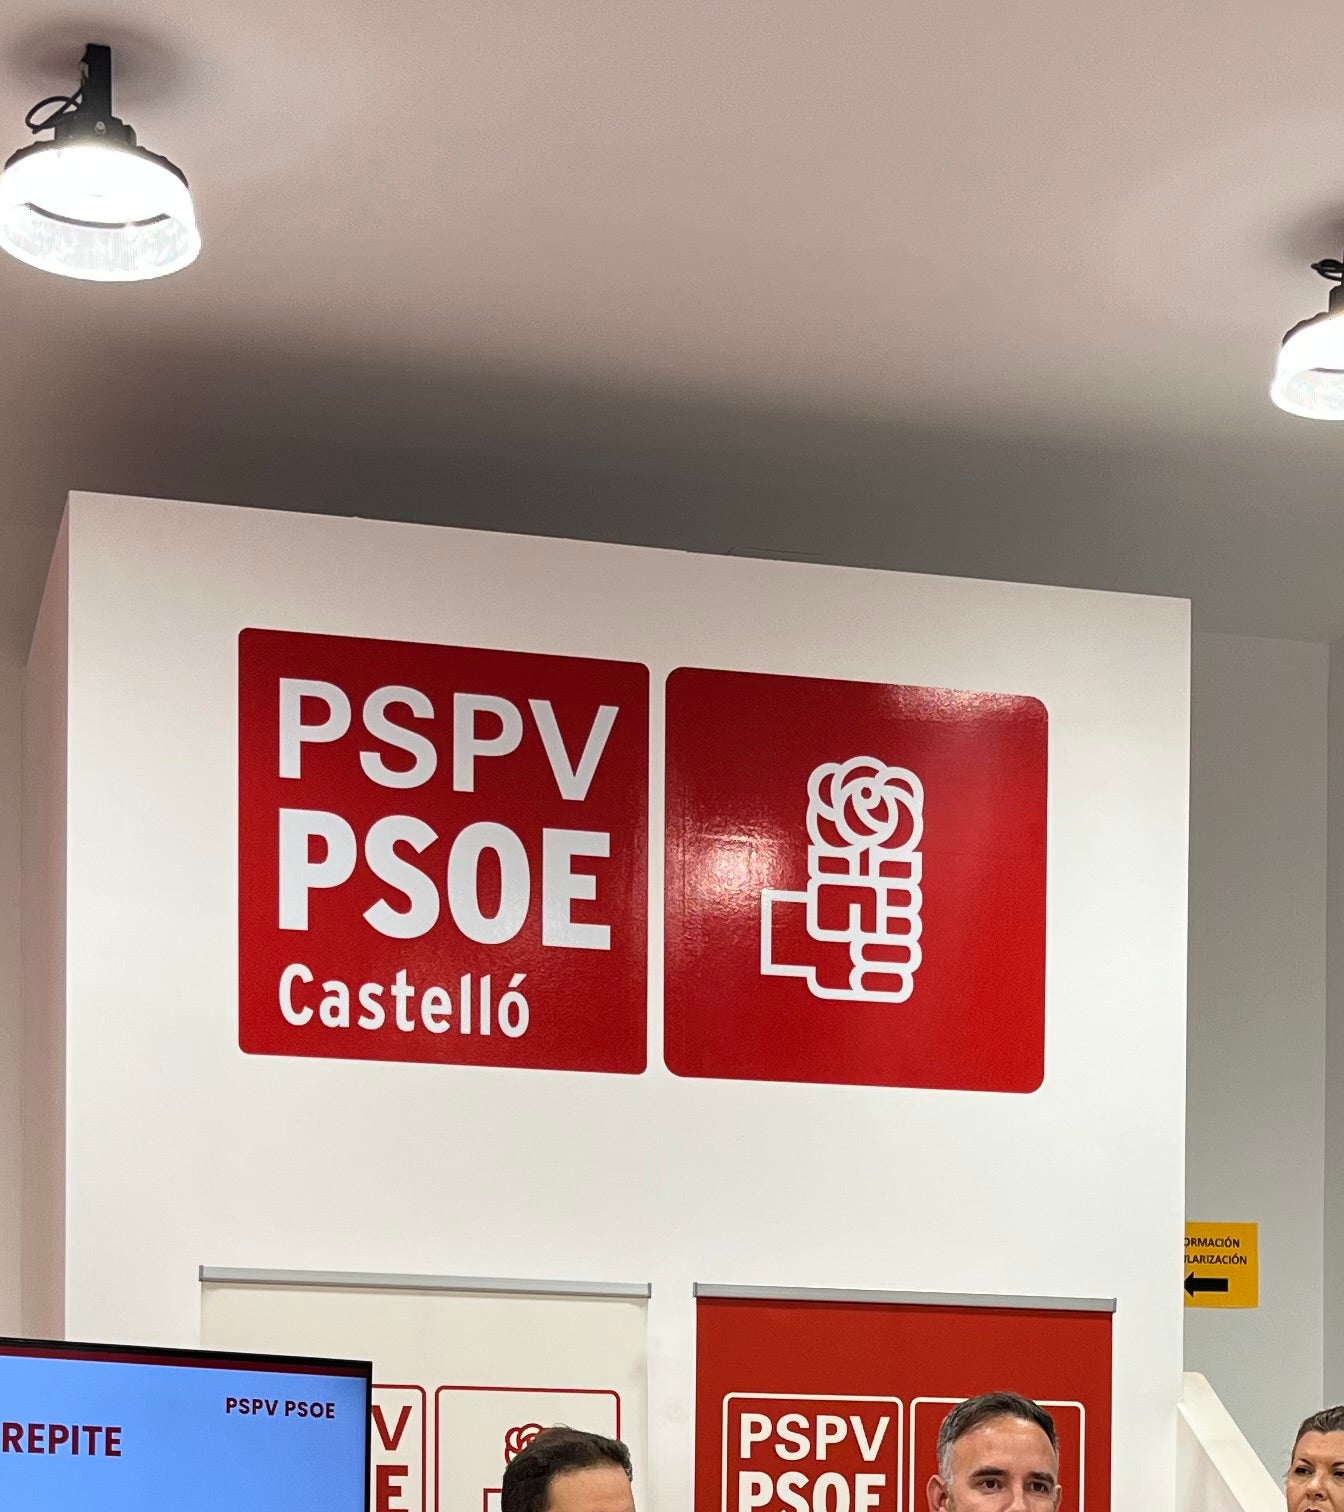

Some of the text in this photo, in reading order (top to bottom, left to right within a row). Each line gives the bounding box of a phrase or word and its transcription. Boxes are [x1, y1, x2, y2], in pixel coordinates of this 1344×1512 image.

[278, 676, 619, 801] PSPV
[278, 807, 612, 951] PSOE
[278, 962, 531, 1038] Castelló
[1184, 1236, 1240, 1248] ORMACIÓN
[1184, 1253, 1247, 1265] LARIZACIÓN
[225, 1397, 336, 1419] PSPV PSOE
[1, 1422, 122, 1457] REPITE
[740, 1412, 891, 1462] PSPV
